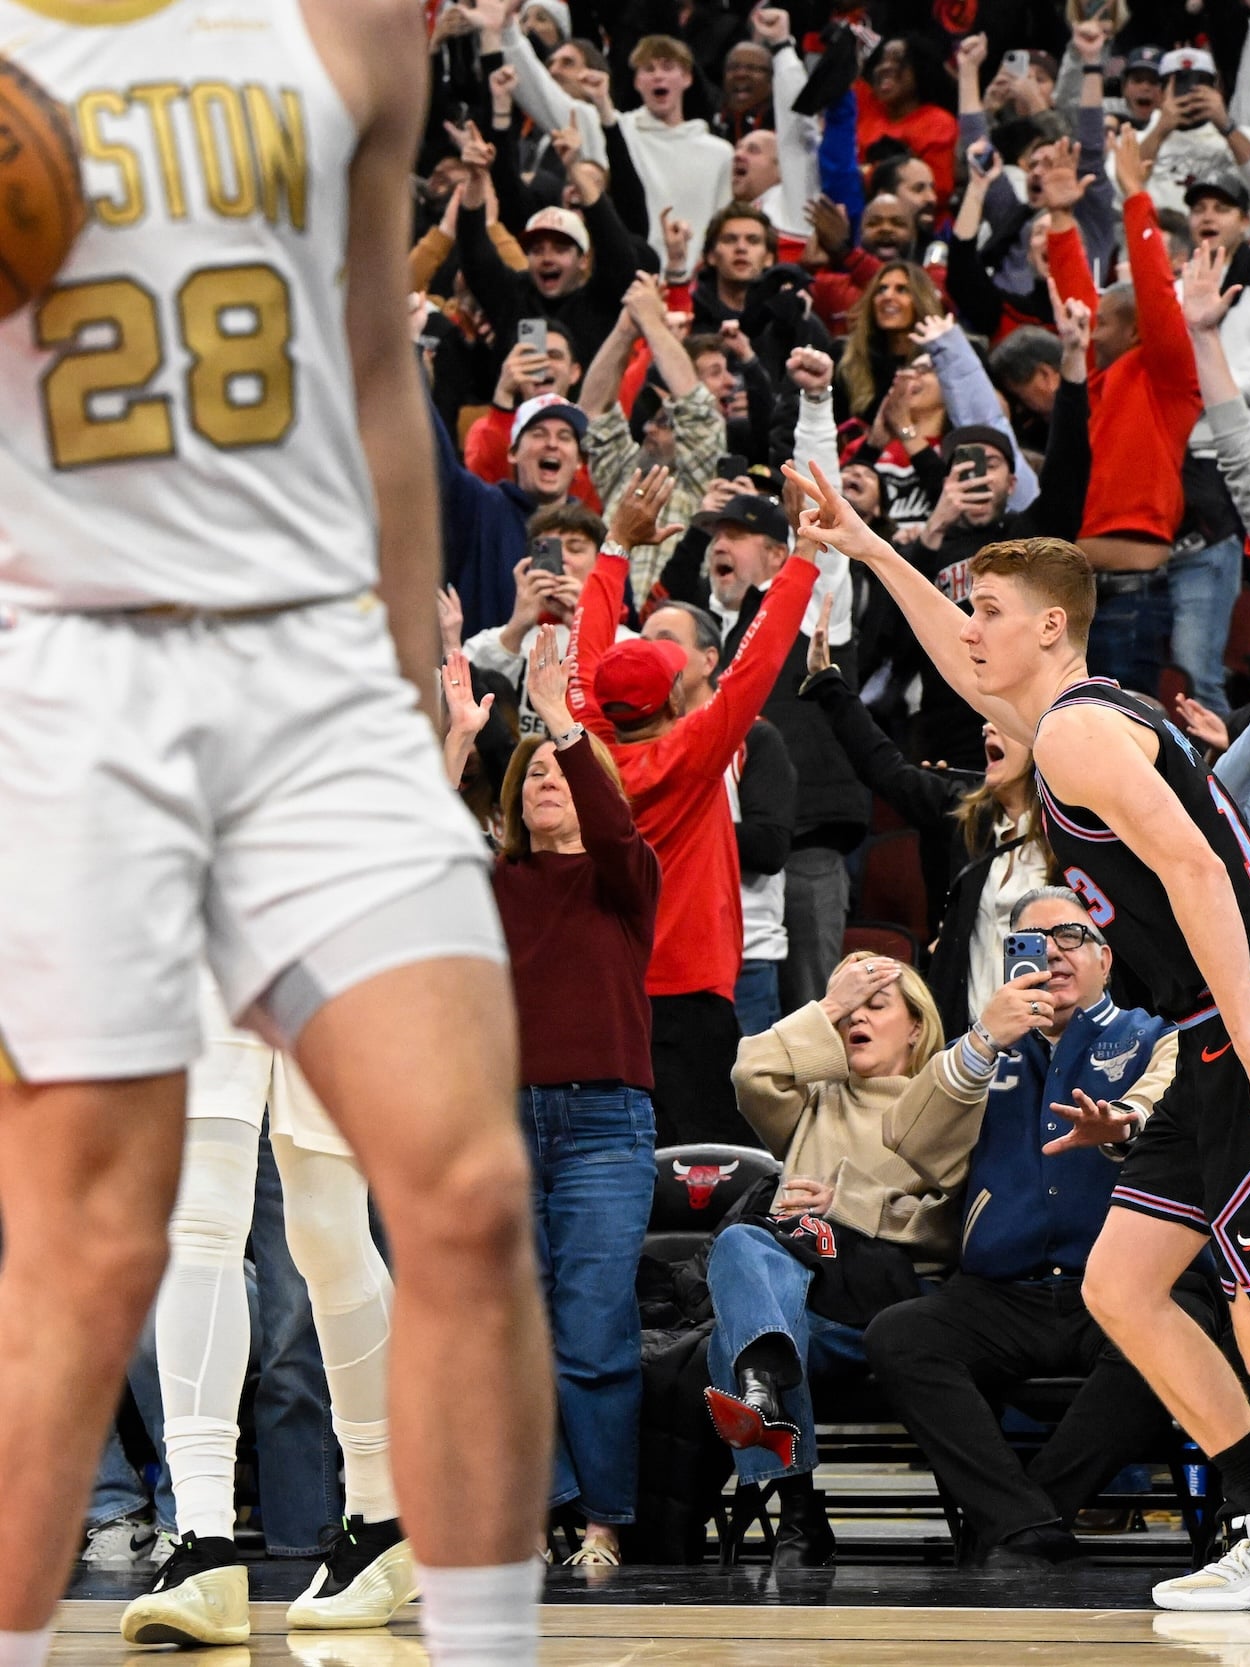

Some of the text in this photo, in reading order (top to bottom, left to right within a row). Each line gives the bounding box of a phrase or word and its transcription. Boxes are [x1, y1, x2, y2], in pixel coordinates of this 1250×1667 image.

[77, 80, 306, 233] STON
[33, 261, 296, 472] 28
[1063, 865, 1116, 928] 3
